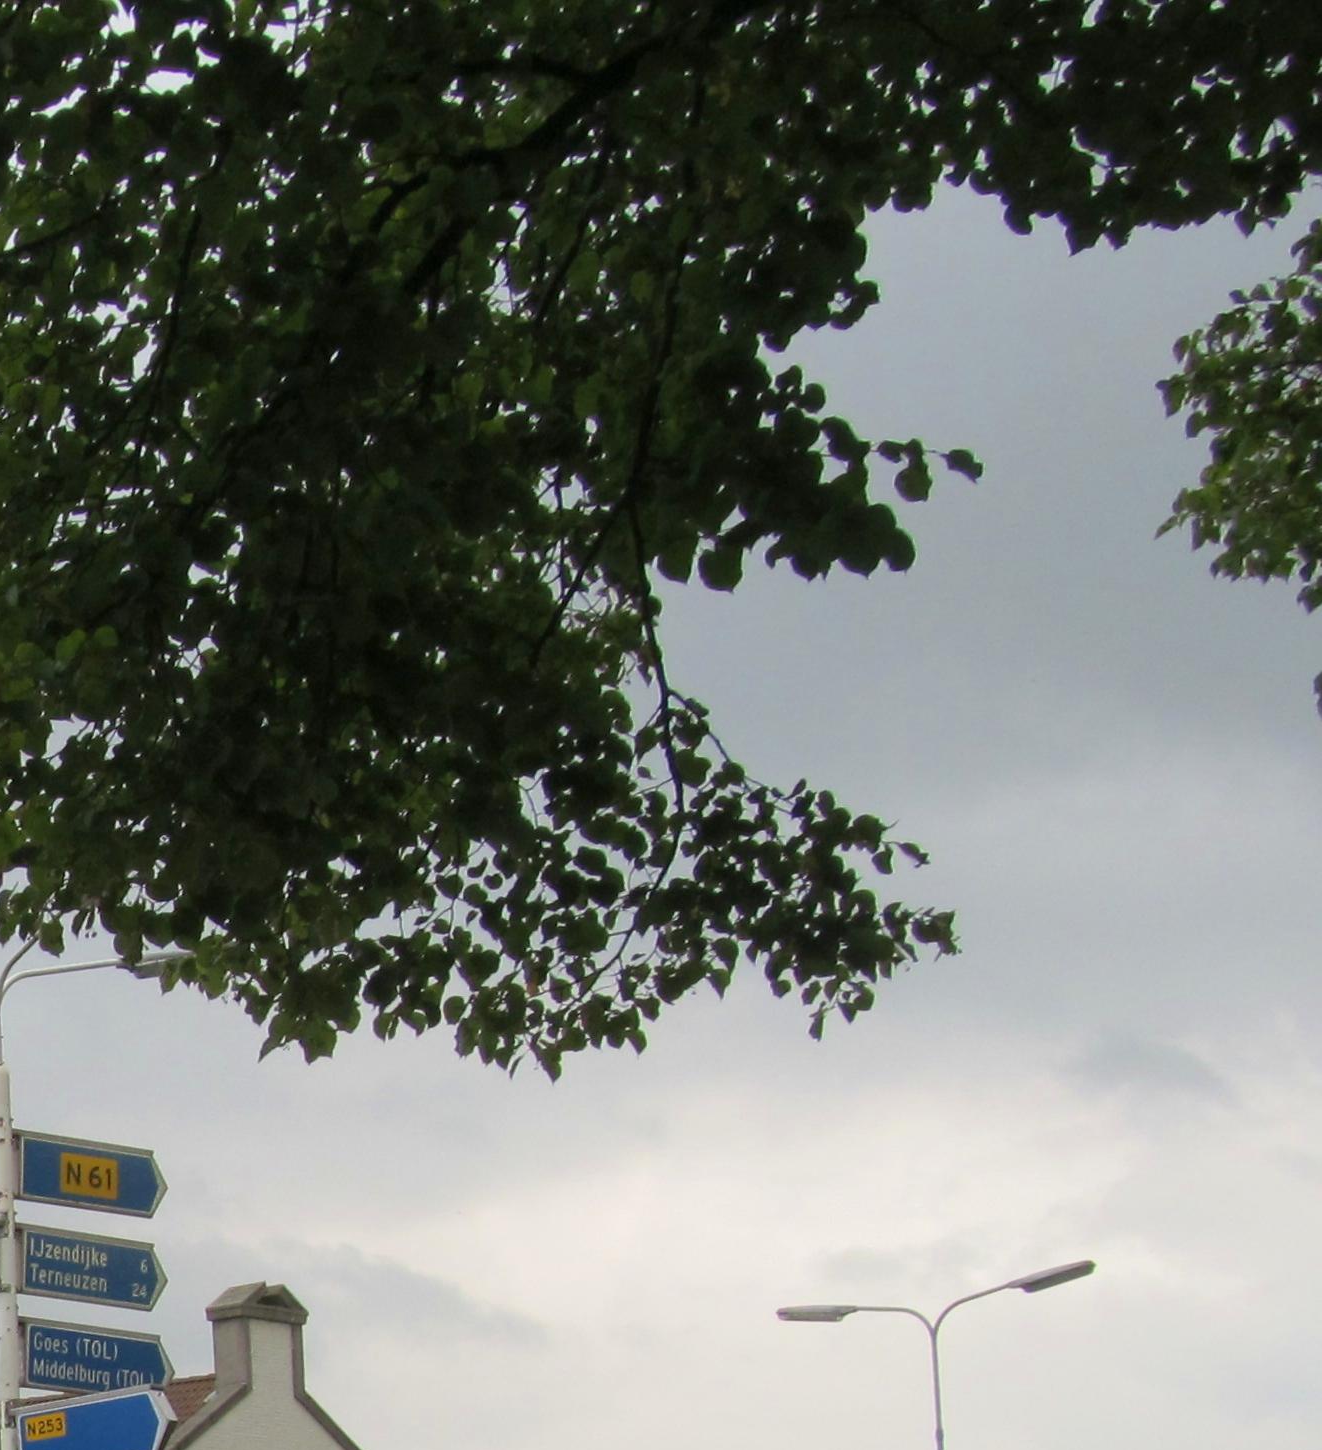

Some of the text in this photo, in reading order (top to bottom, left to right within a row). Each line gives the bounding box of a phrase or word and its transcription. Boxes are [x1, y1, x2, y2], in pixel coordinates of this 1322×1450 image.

[66, 1161, 111, 1190] N 61
[30, 1237, 148, 1273] IJzendijke 6
[30, 1263, 148, 1298] Terneuzen 24
[34, 1332, 118, 1361] Goes (TOL)
[33, 1358, 110, 1391] Middelburg
[27, 1418, 64, 1436] N253
